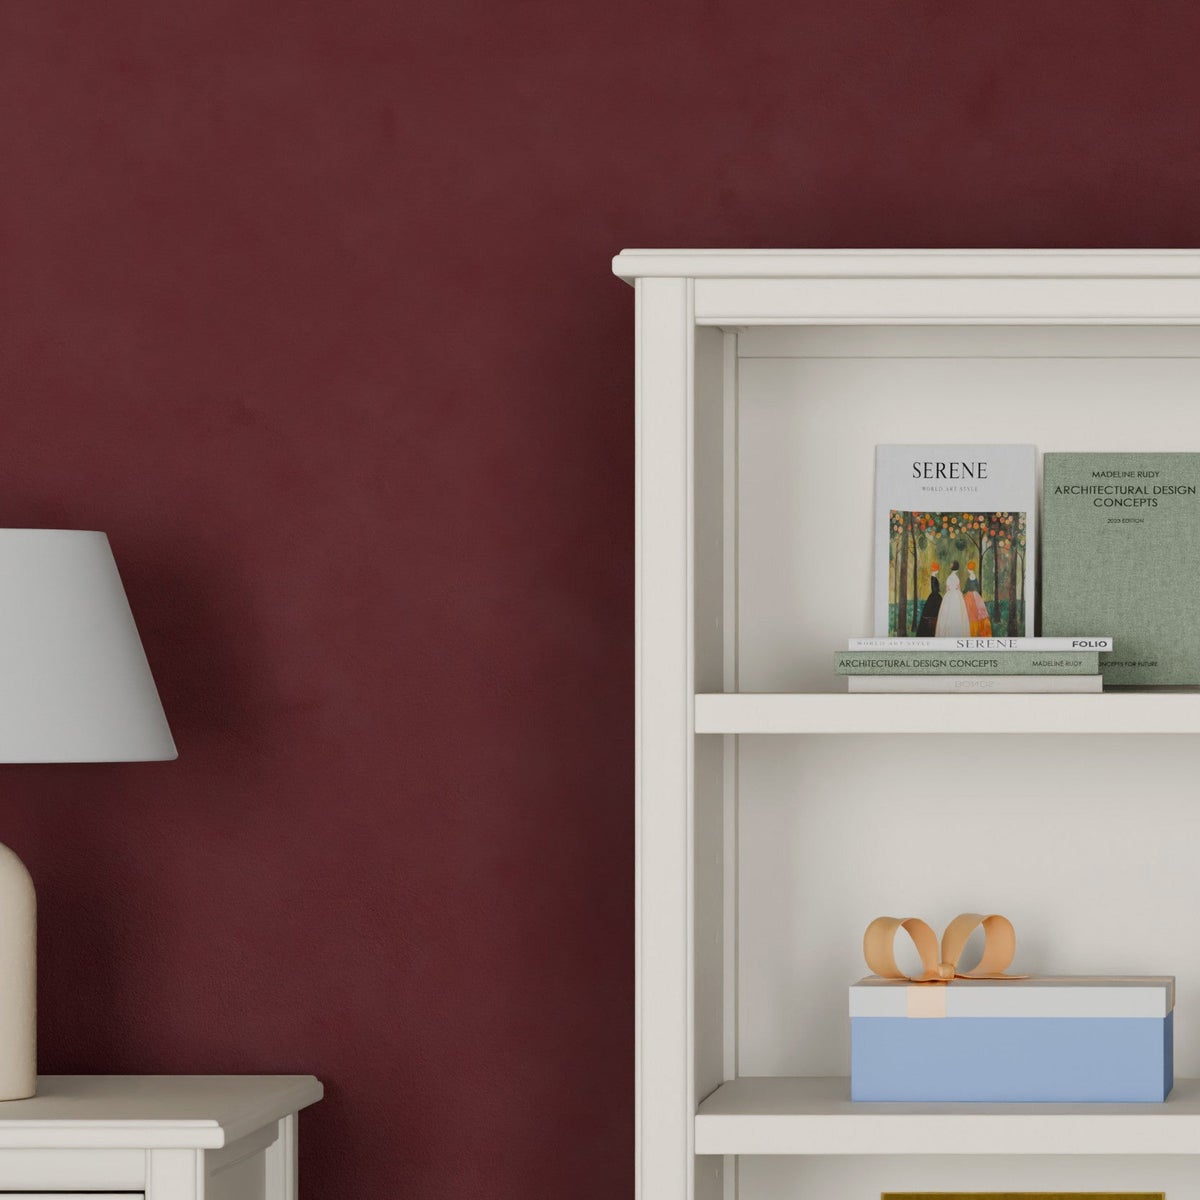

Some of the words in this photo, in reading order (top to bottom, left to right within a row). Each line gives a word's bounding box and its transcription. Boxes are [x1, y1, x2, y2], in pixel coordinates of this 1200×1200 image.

[912, 462, 988, 479] SERENE
[1054, 485, 1149, 495] ARCHITECTURAL
[1153, 485, 1196, 495] DESIGN
[1093, 498, 1158, 507] CONCEPTS
[956, 639, 1018, 649] SERENE
[839, 660, 910, 668] ARCHITECTURAL
[913, 660, 946, 668] DESIGN
[949, 660, 998, 668] CONCEPTS
